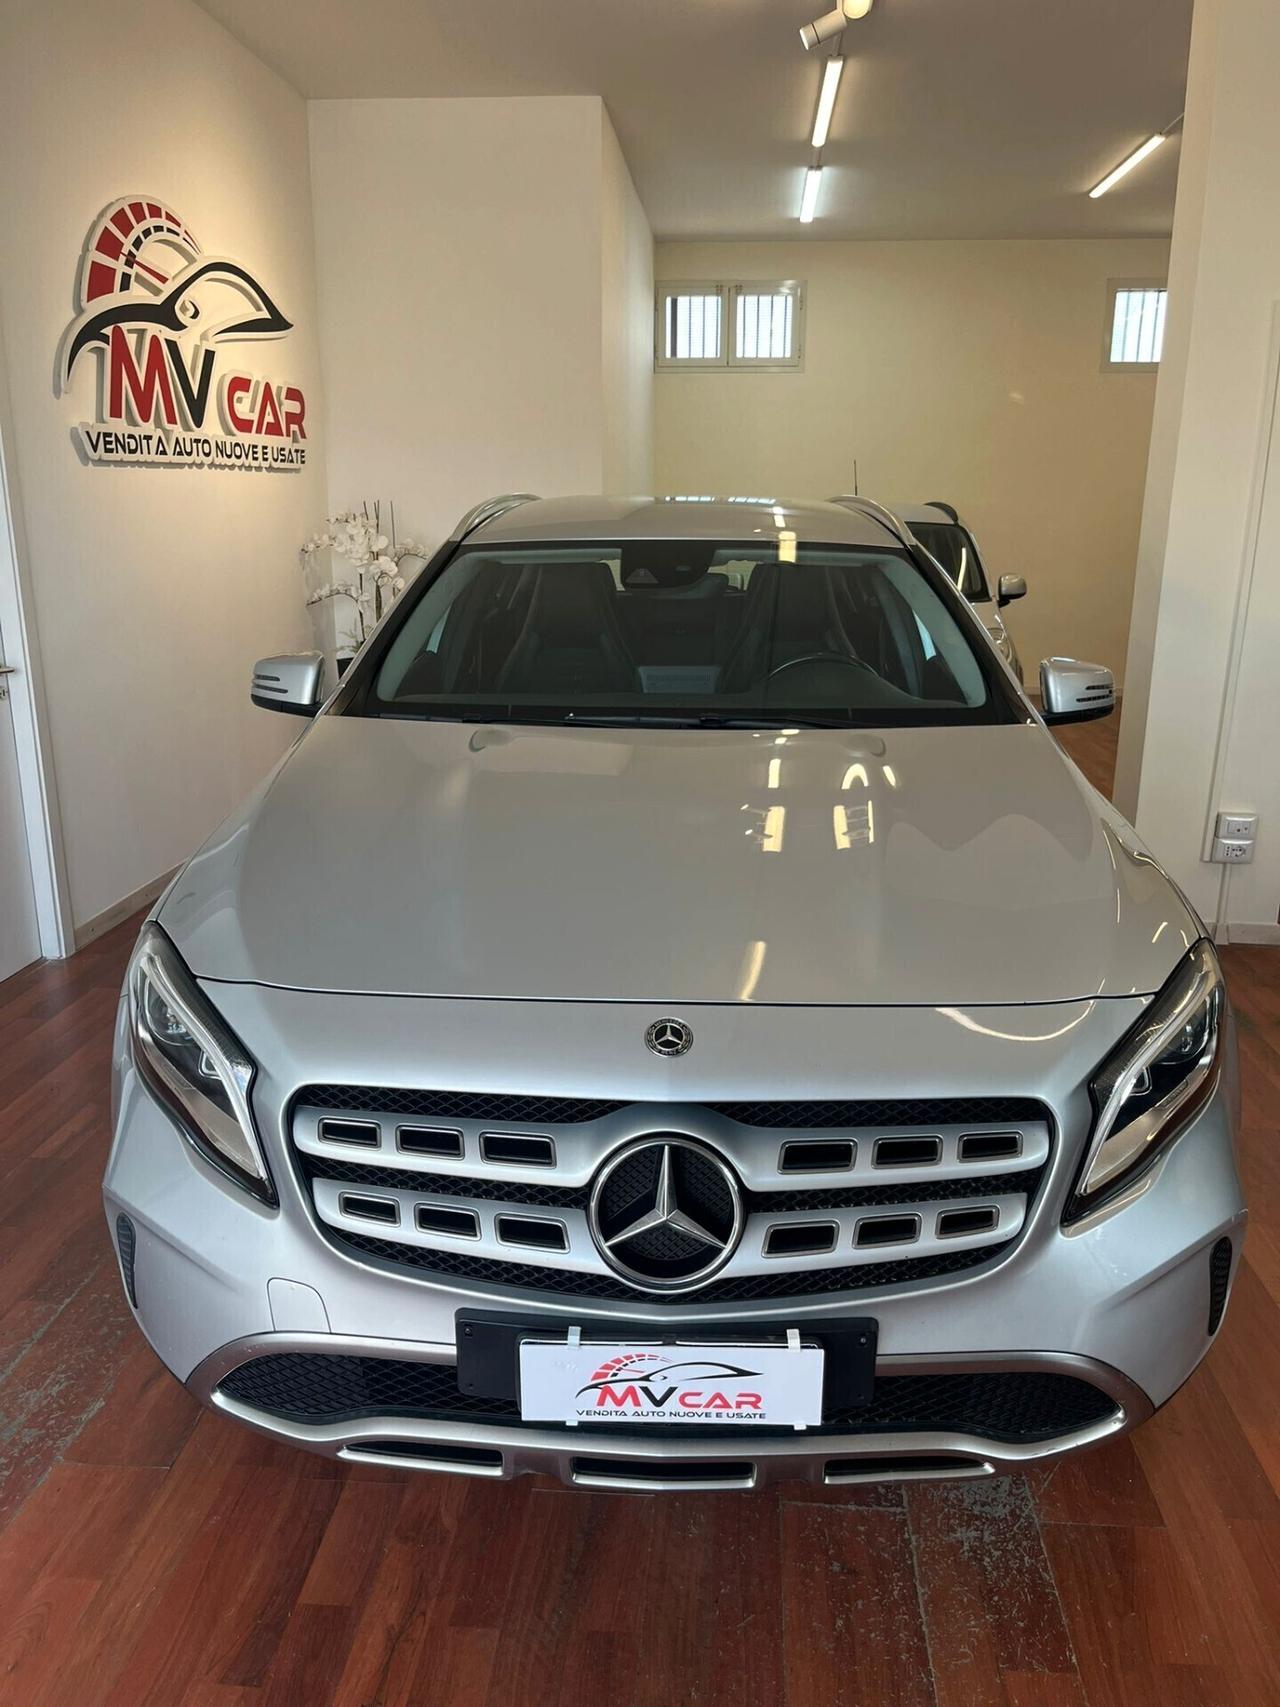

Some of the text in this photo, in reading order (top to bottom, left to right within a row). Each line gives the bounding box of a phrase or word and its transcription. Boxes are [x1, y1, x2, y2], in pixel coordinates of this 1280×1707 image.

[227, 376, 307, 440] CAR
[173, 437, 211, 458] AUTO
[215, 440, 259, 462] NUOVE
[262, 445, 269, 461] E
[271, 447, 306, 465] USATE
[576, 1409, 628, 1417] VENDITA
[669, 1411, 713, 1419] NUOVE
[715, 1411, 724, 1419] E
[726, 1412, 767, 1420] USATE
